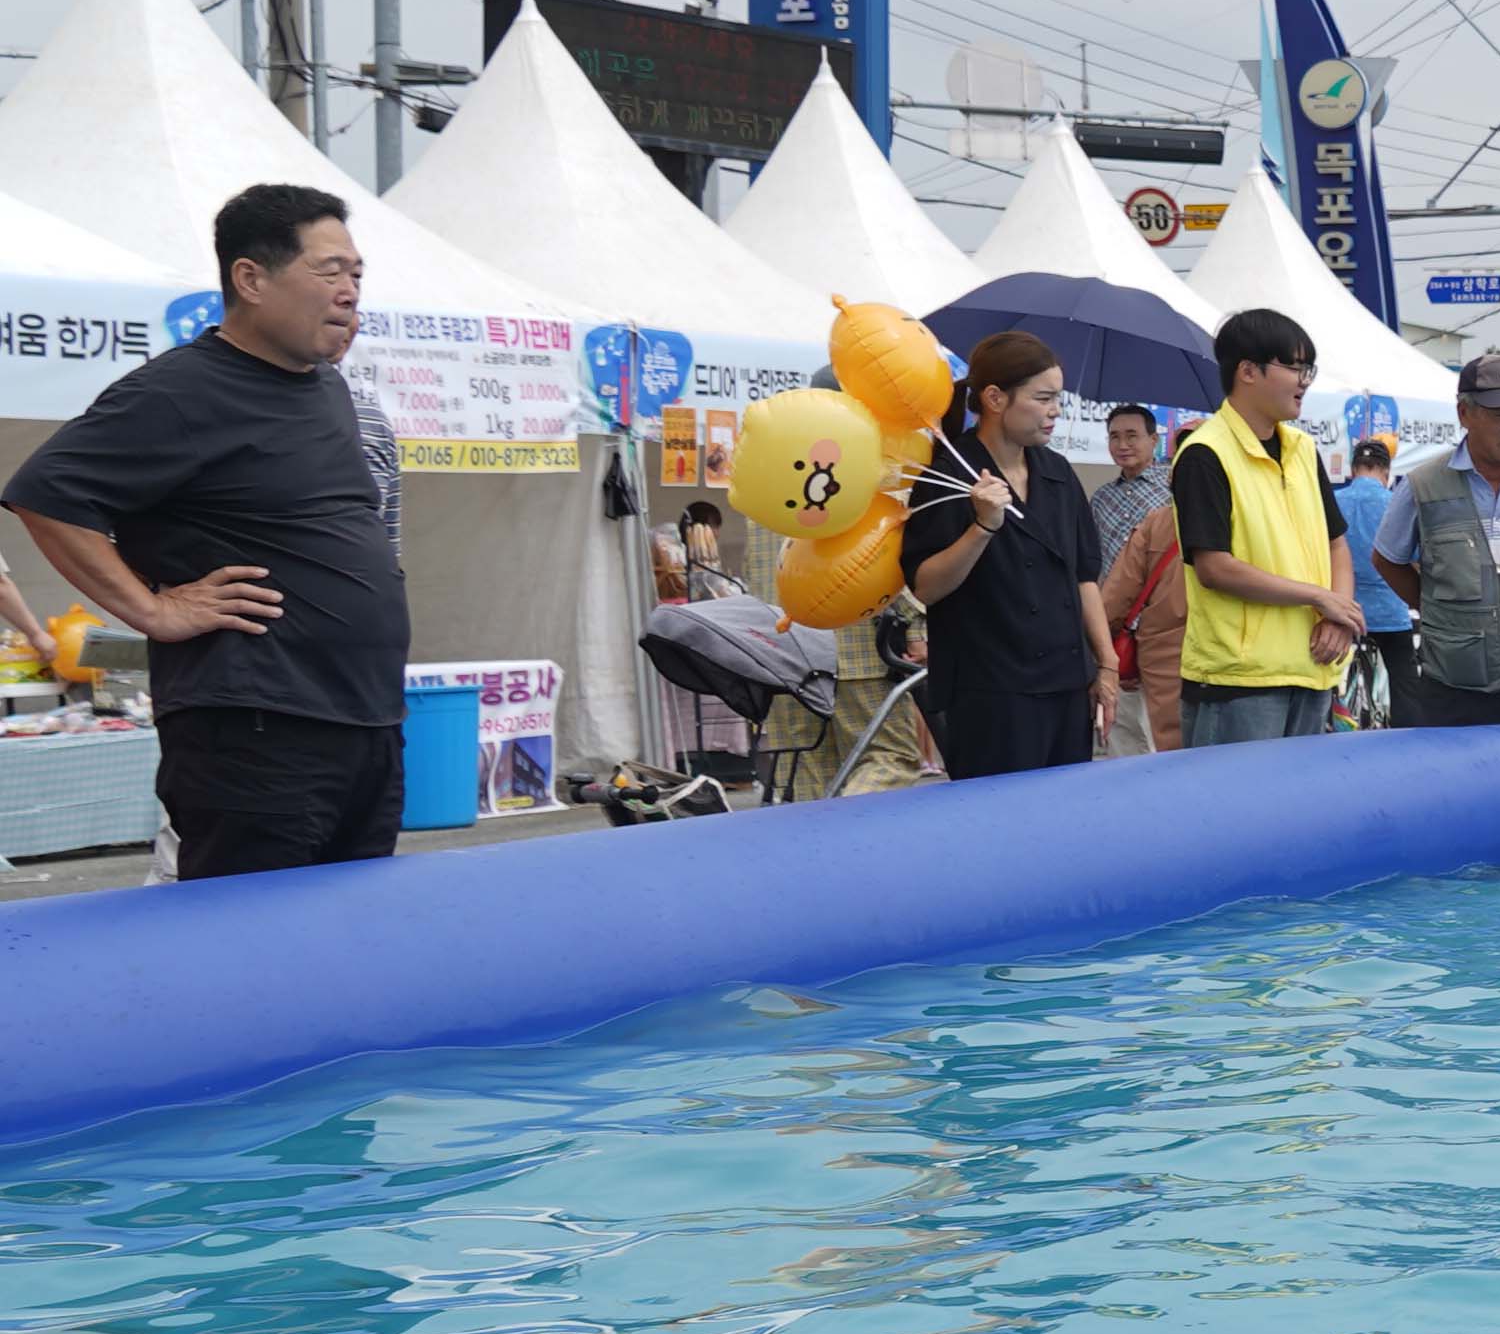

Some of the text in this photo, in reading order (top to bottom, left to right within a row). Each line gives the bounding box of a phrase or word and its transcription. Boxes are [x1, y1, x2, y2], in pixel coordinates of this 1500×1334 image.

[1135, 203, 1169, 231] 50
[57, 316, 151, 364] 한가득
[486, 315, 572, 352] 특가판매
[469, 378, 511, 405] 500g
[695, 364, 738, 400] 드디어
[486, 414, 515, 440] 1kg
